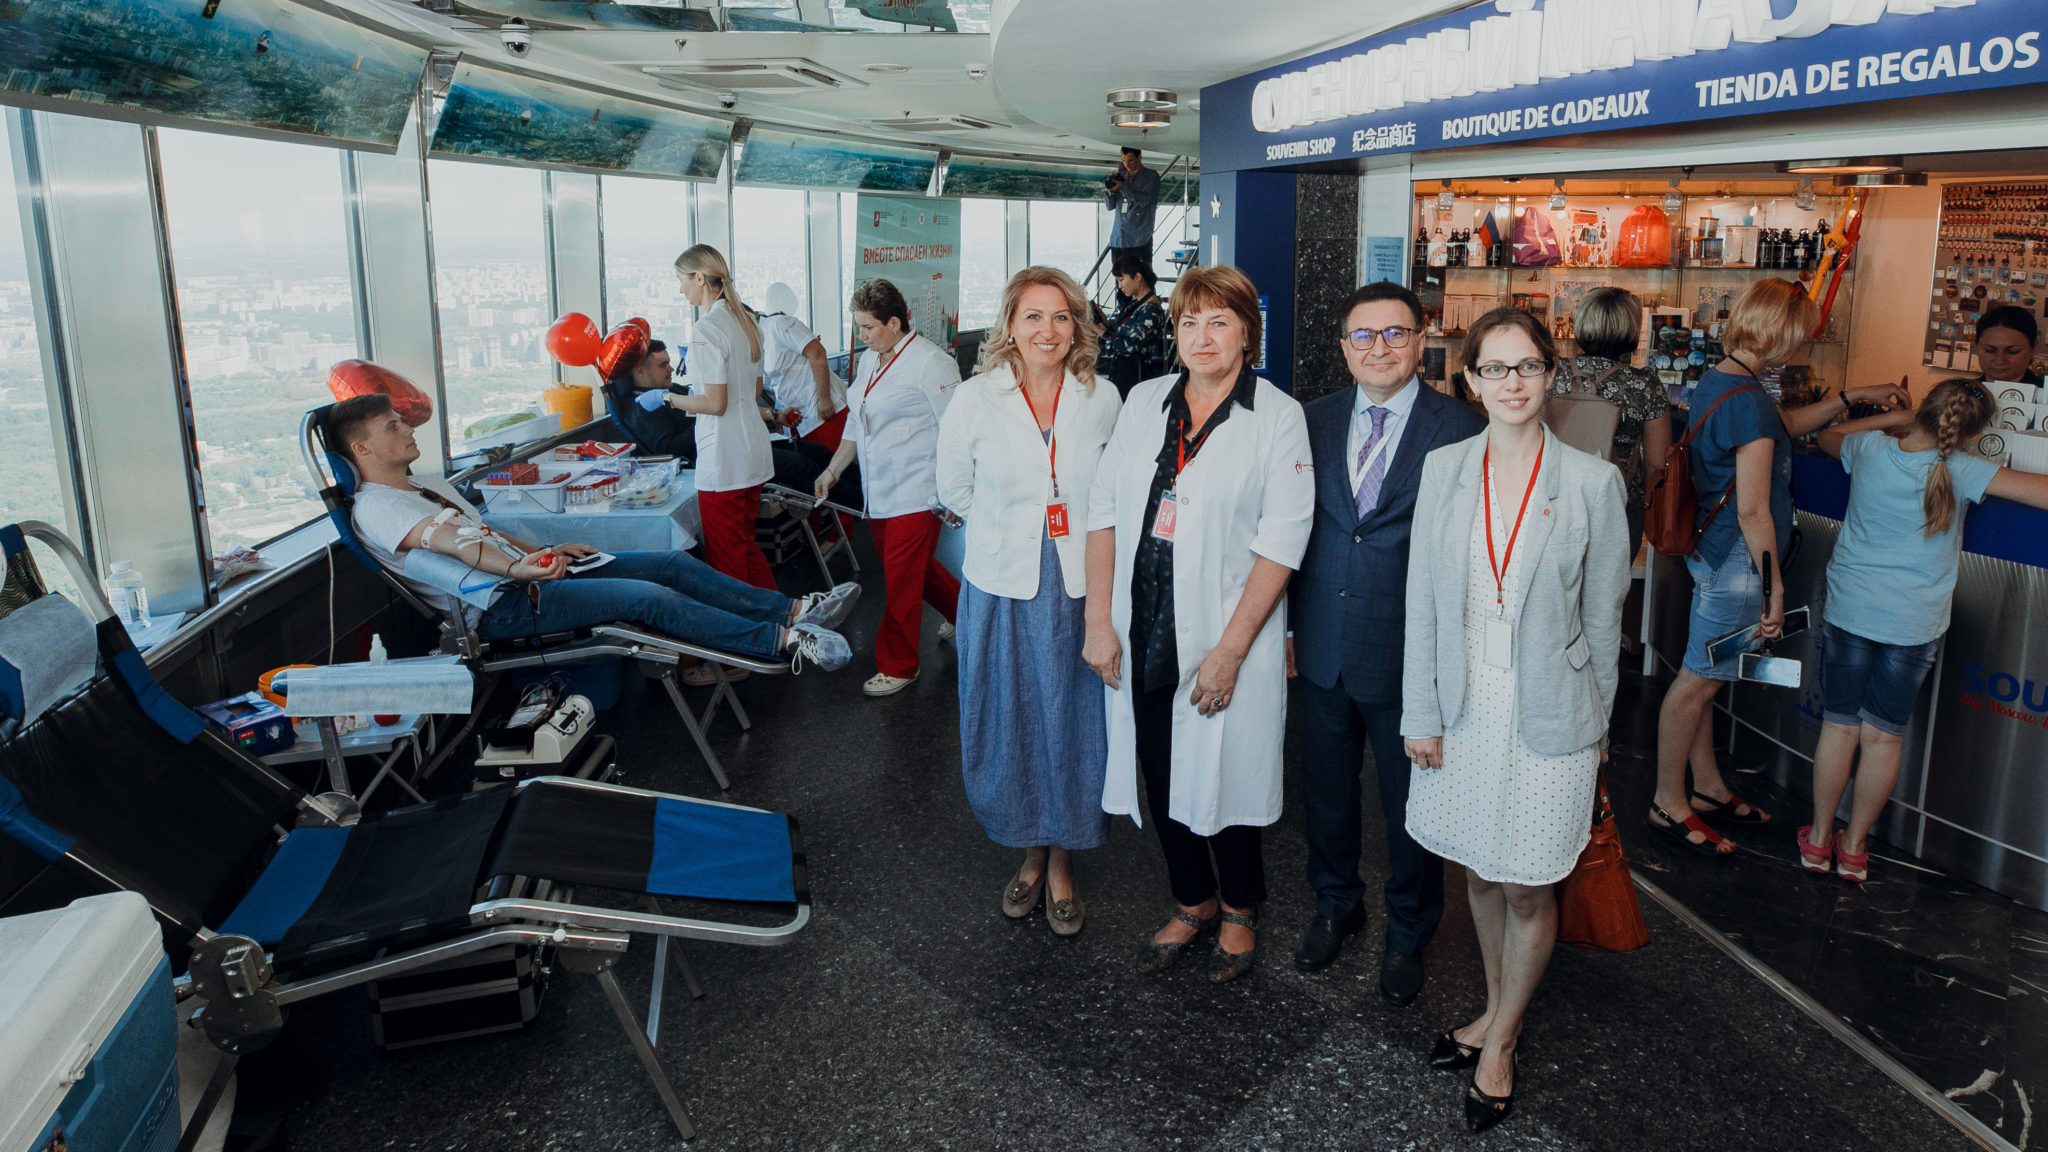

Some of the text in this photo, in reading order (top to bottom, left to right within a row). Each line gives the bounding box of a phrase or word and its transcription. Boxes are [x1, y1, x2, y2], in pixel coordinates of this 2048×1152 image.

[1251, 0, 1543, 133] СУВЕНИРНЫЙ
[1695, 31, 2040, 108] TIENDA DE REGALOS
[1442, 89, 1650, 140] BOUTIQUE DE CADEAUX
[1266, 137, 1336, 161] SOUVENIR SHOP
[1352, 122, 1417, 153] 纪念品商店
[864, 246, 894, 264] ВМЕСТЕ
[895, 245, 928, 261] СПАСАЕМ
